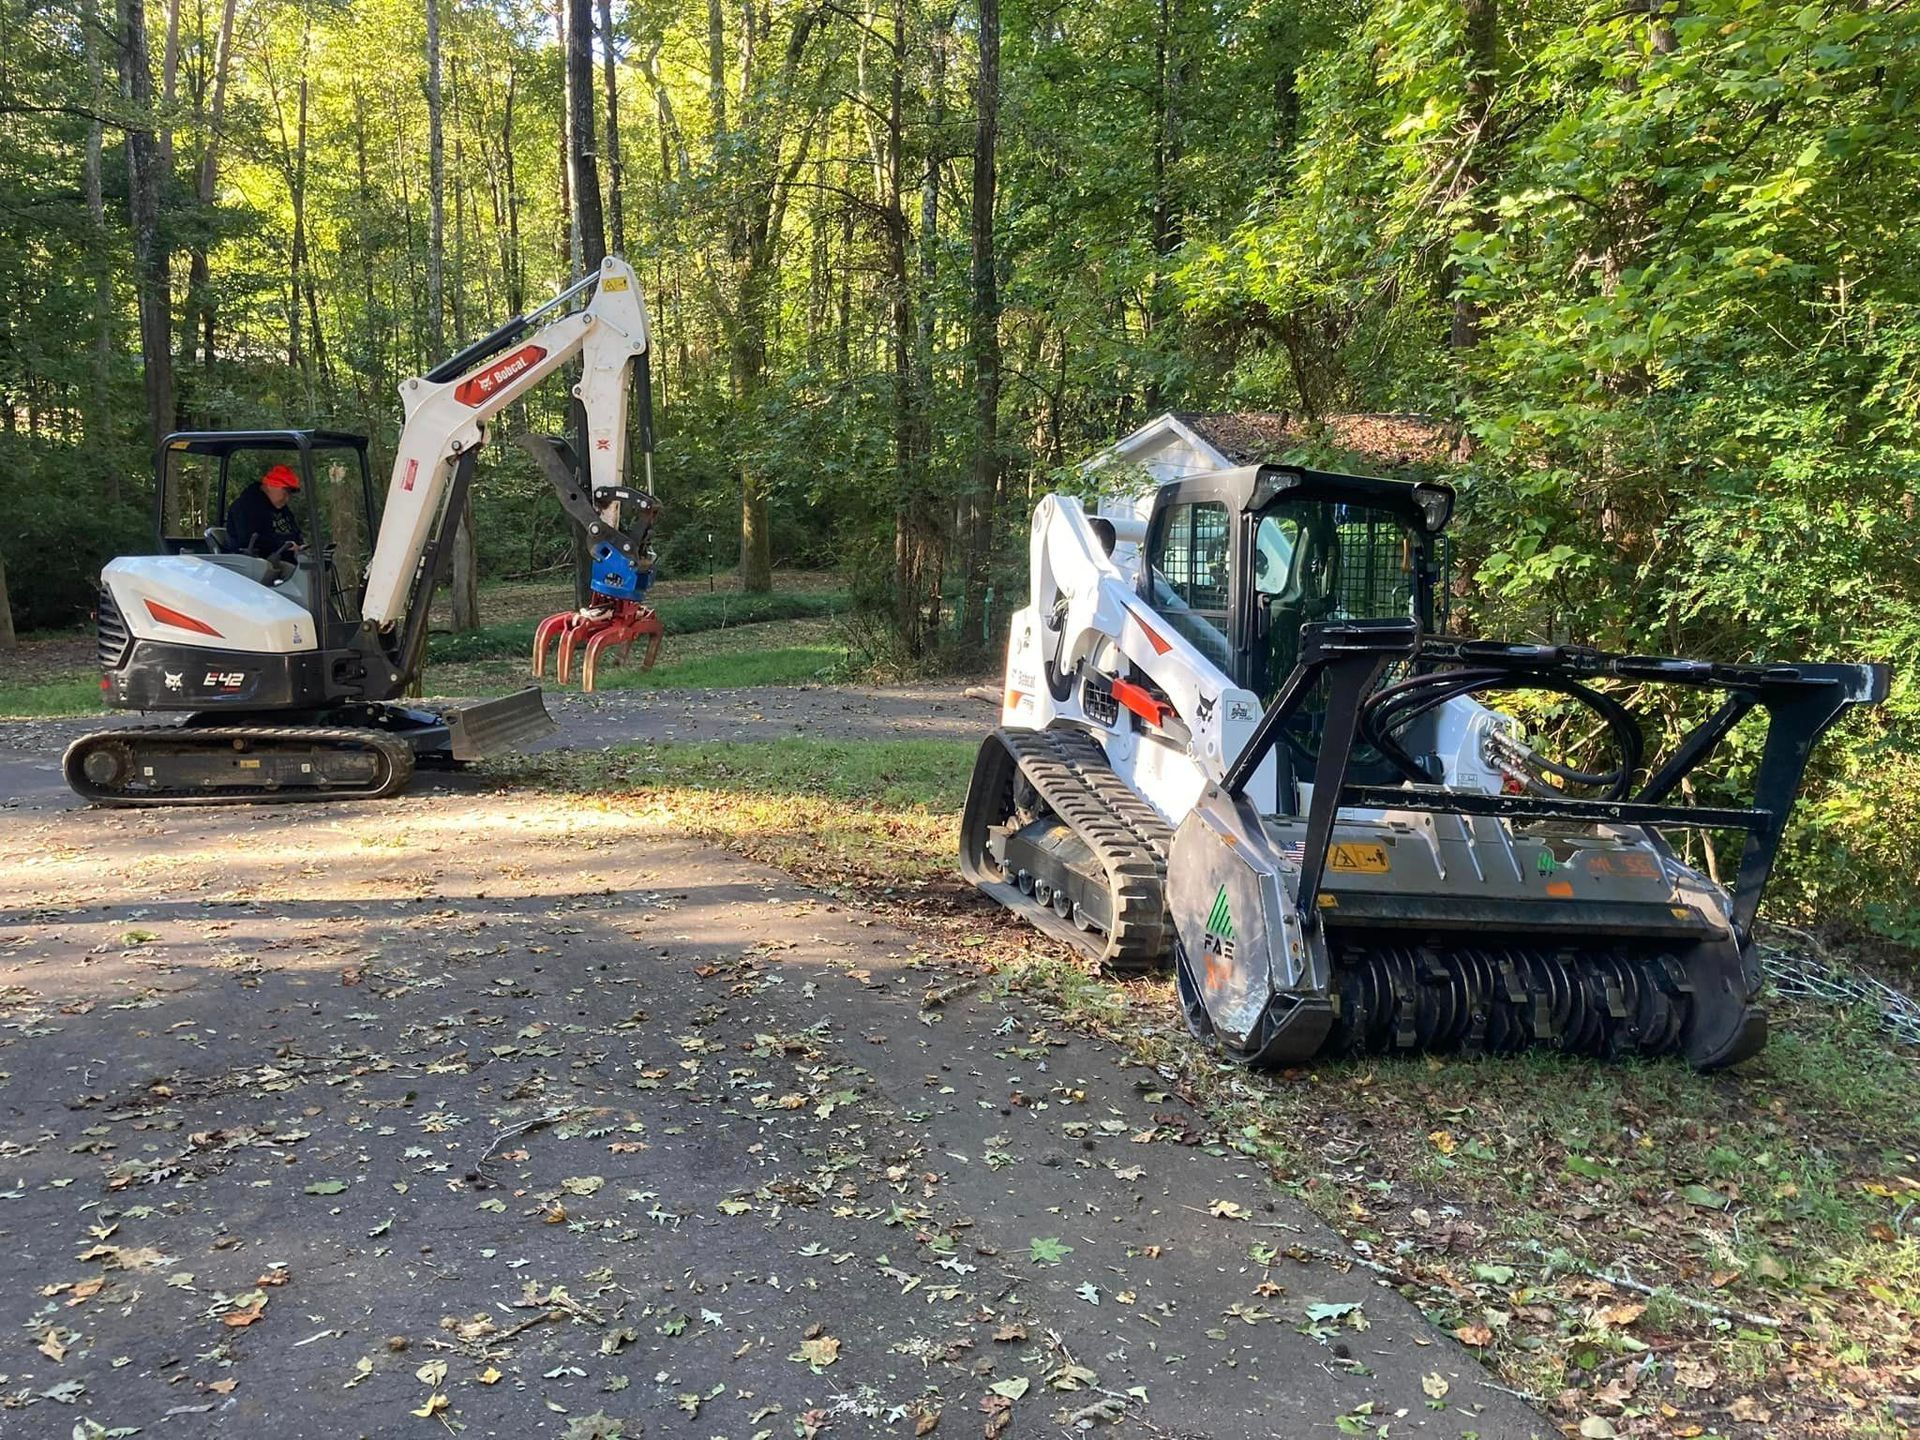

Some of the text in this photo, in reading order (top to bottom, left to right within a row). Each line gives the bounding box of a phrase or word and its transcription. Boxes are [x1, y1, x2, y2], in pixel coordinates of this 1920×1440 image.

[493, 356, 529, 384] Bobcat
[203, 671, 245, 686] E42
[1203, 933, 1235, 961] FAE
